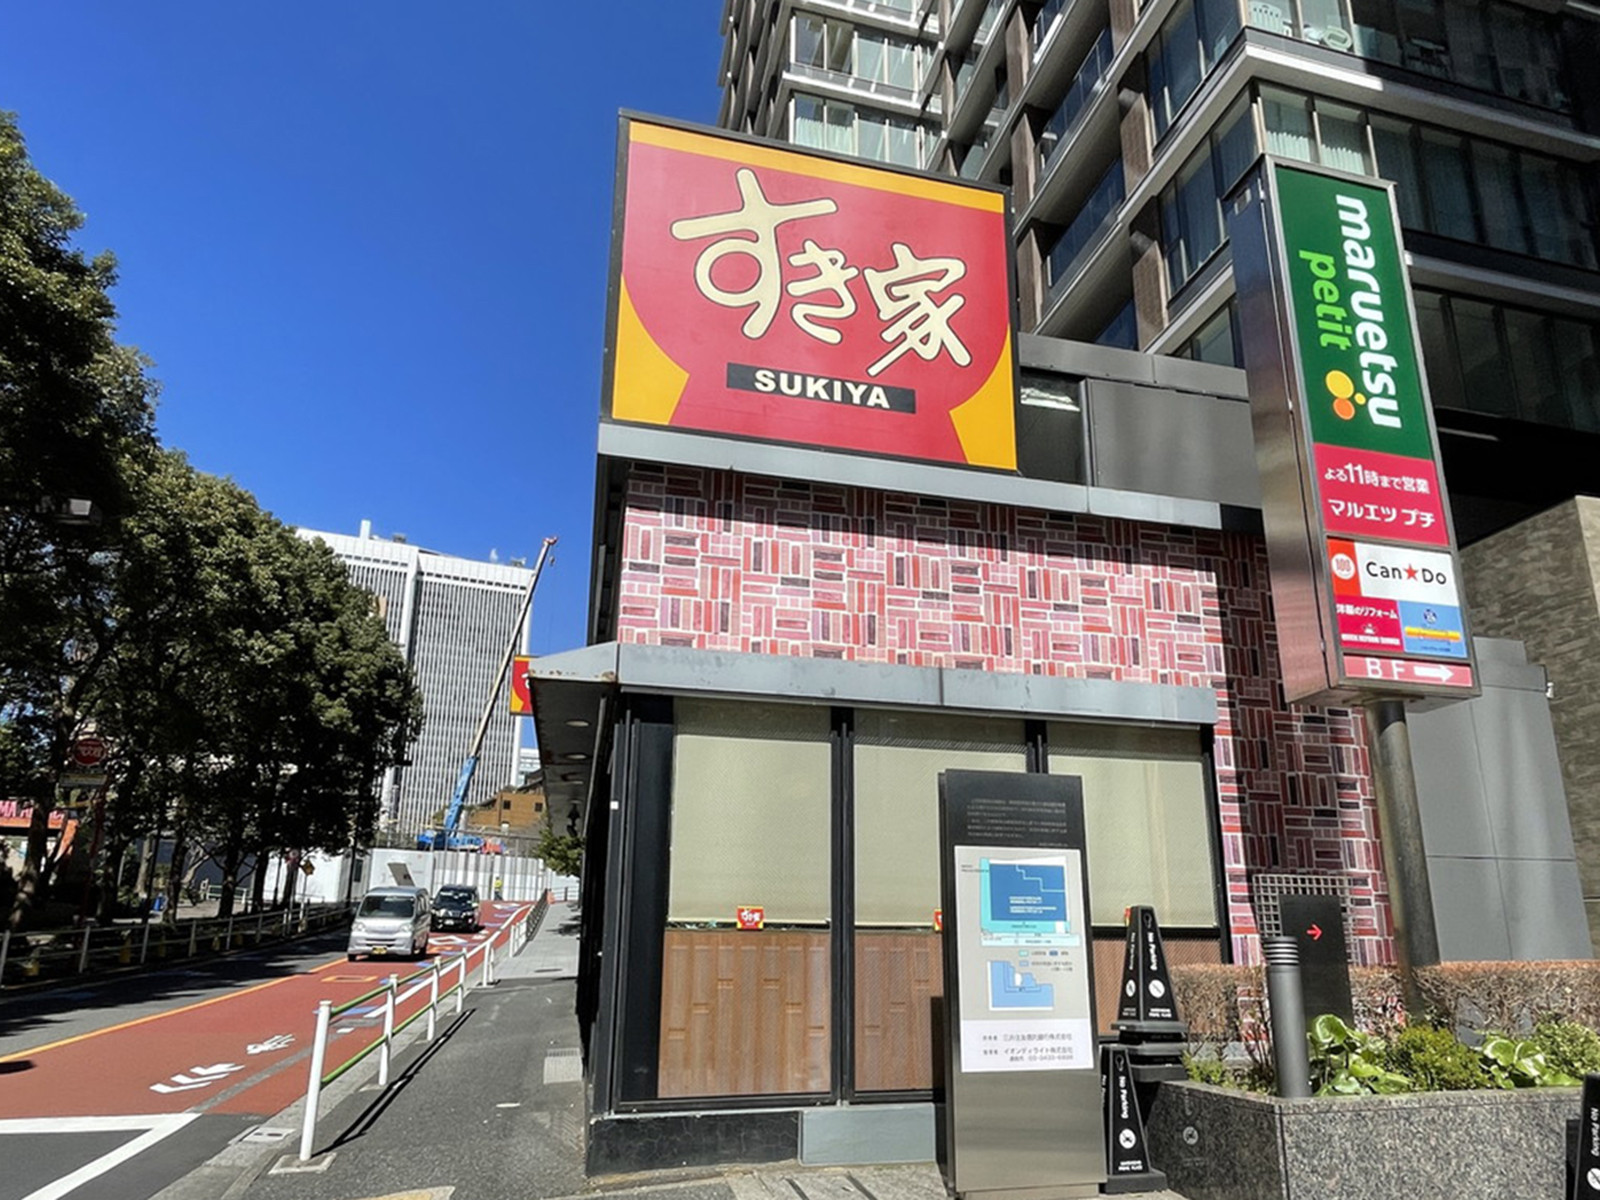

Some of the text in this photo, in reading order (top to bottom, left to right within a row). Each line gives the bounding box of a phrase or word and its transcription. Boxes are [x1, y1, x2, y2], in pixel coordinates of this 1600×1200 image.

[670, 167, 972, 377] すき家
[1299, 250, 1352, 350] petit
[1336, 194, 1402, 428] maruetsu
[754, 368, 891, 409] SUKIYA
[1324, 462, 1430, 494] よる11時まで営業
[1327, 498, 1436, 528] マルエツ プチ
